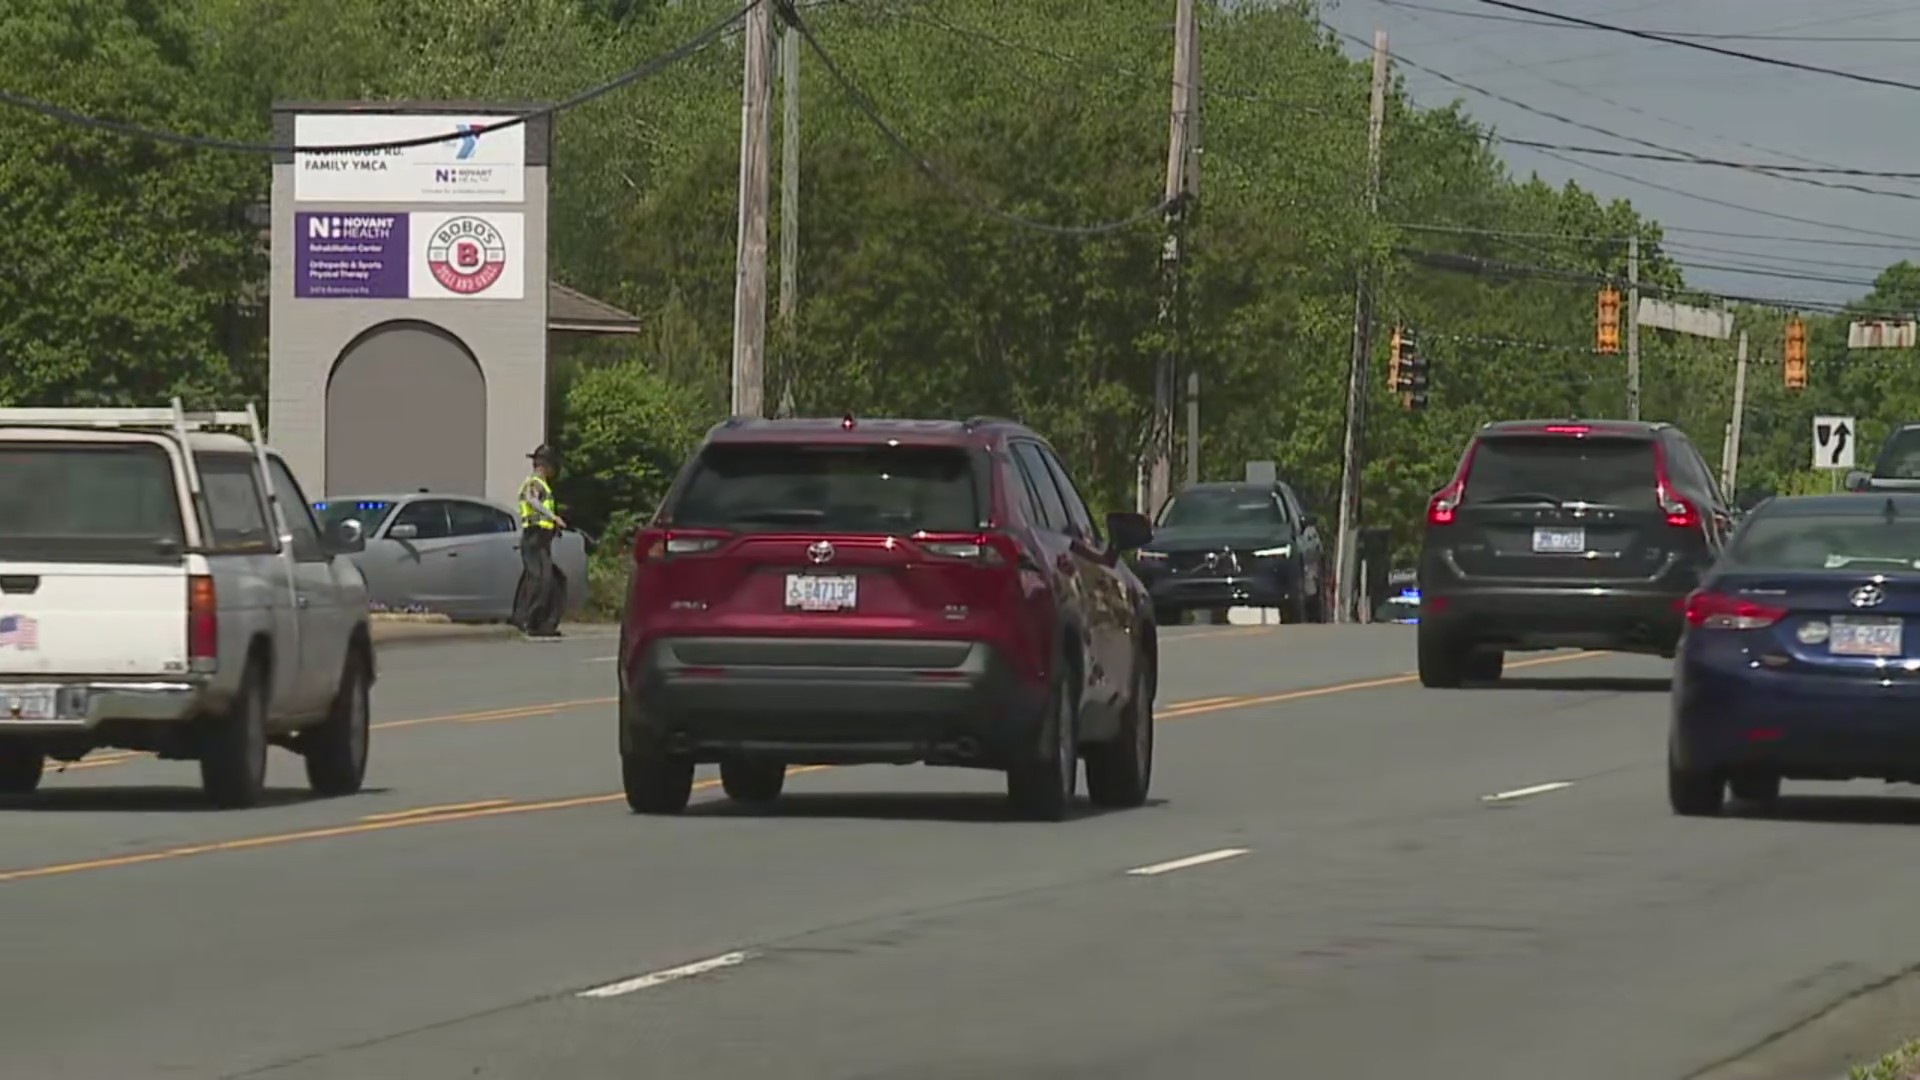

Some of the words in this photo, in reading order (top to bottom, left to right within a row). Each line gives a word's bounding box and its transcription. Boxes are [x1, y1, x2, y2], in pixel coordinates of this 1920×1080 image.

[305, 160, 348, 171] FAMILY
[352, 160, 387, 171] YMCA
[343, 217, 394, 227] NOVANT
[343, 228, 390, 238] HEALTH
[438, 220, 496, 244] BOBO'S
[457, 242, 479, 267] B
